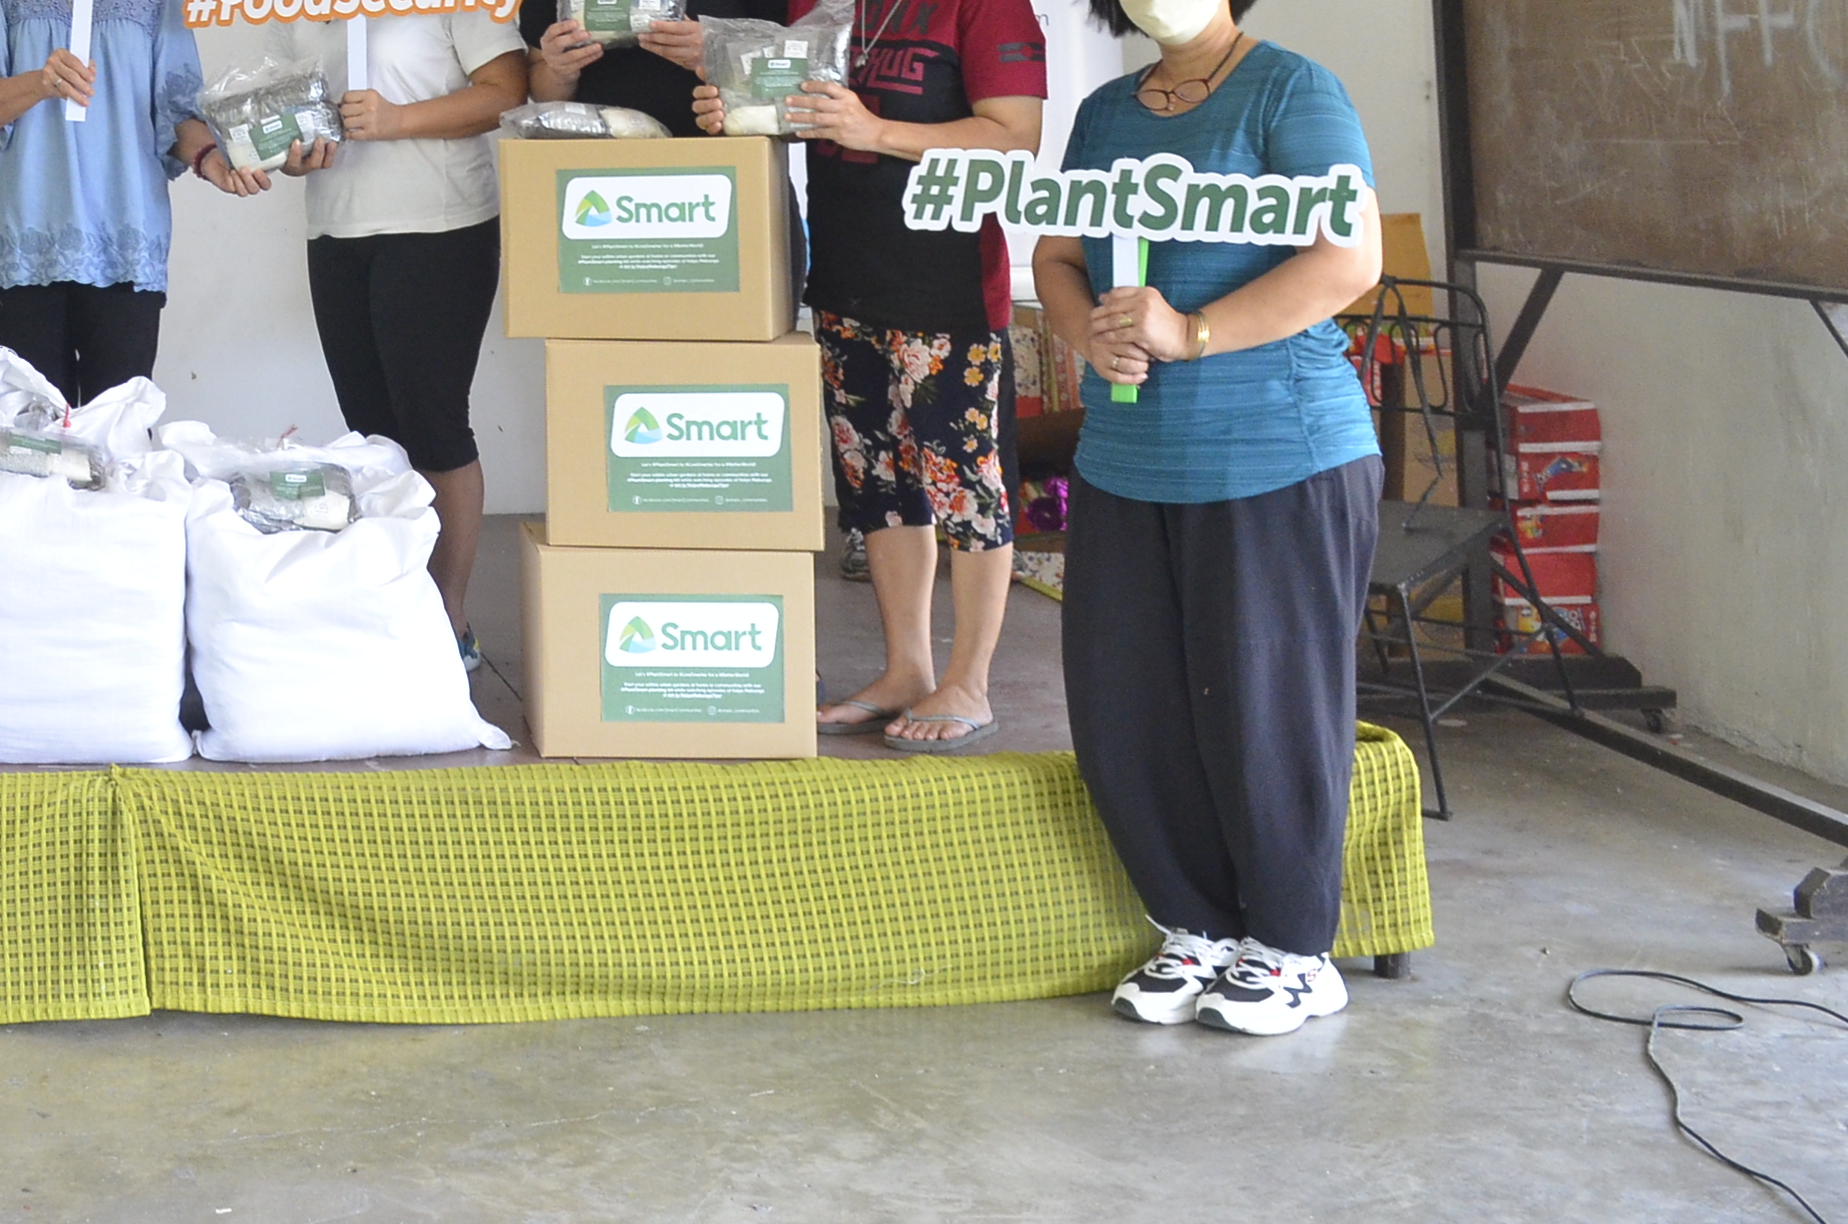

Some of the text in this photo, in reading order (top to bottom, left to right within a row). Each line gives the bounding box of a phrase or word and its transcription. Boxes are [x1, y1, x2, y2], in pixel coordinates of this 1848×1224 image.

[615, 194, 716, 223] Smart
[910, 157, 1358, 238] #PlantSmart
[666, 412, 769, 441] Smart
[660, 622, 762, 652] Smart
